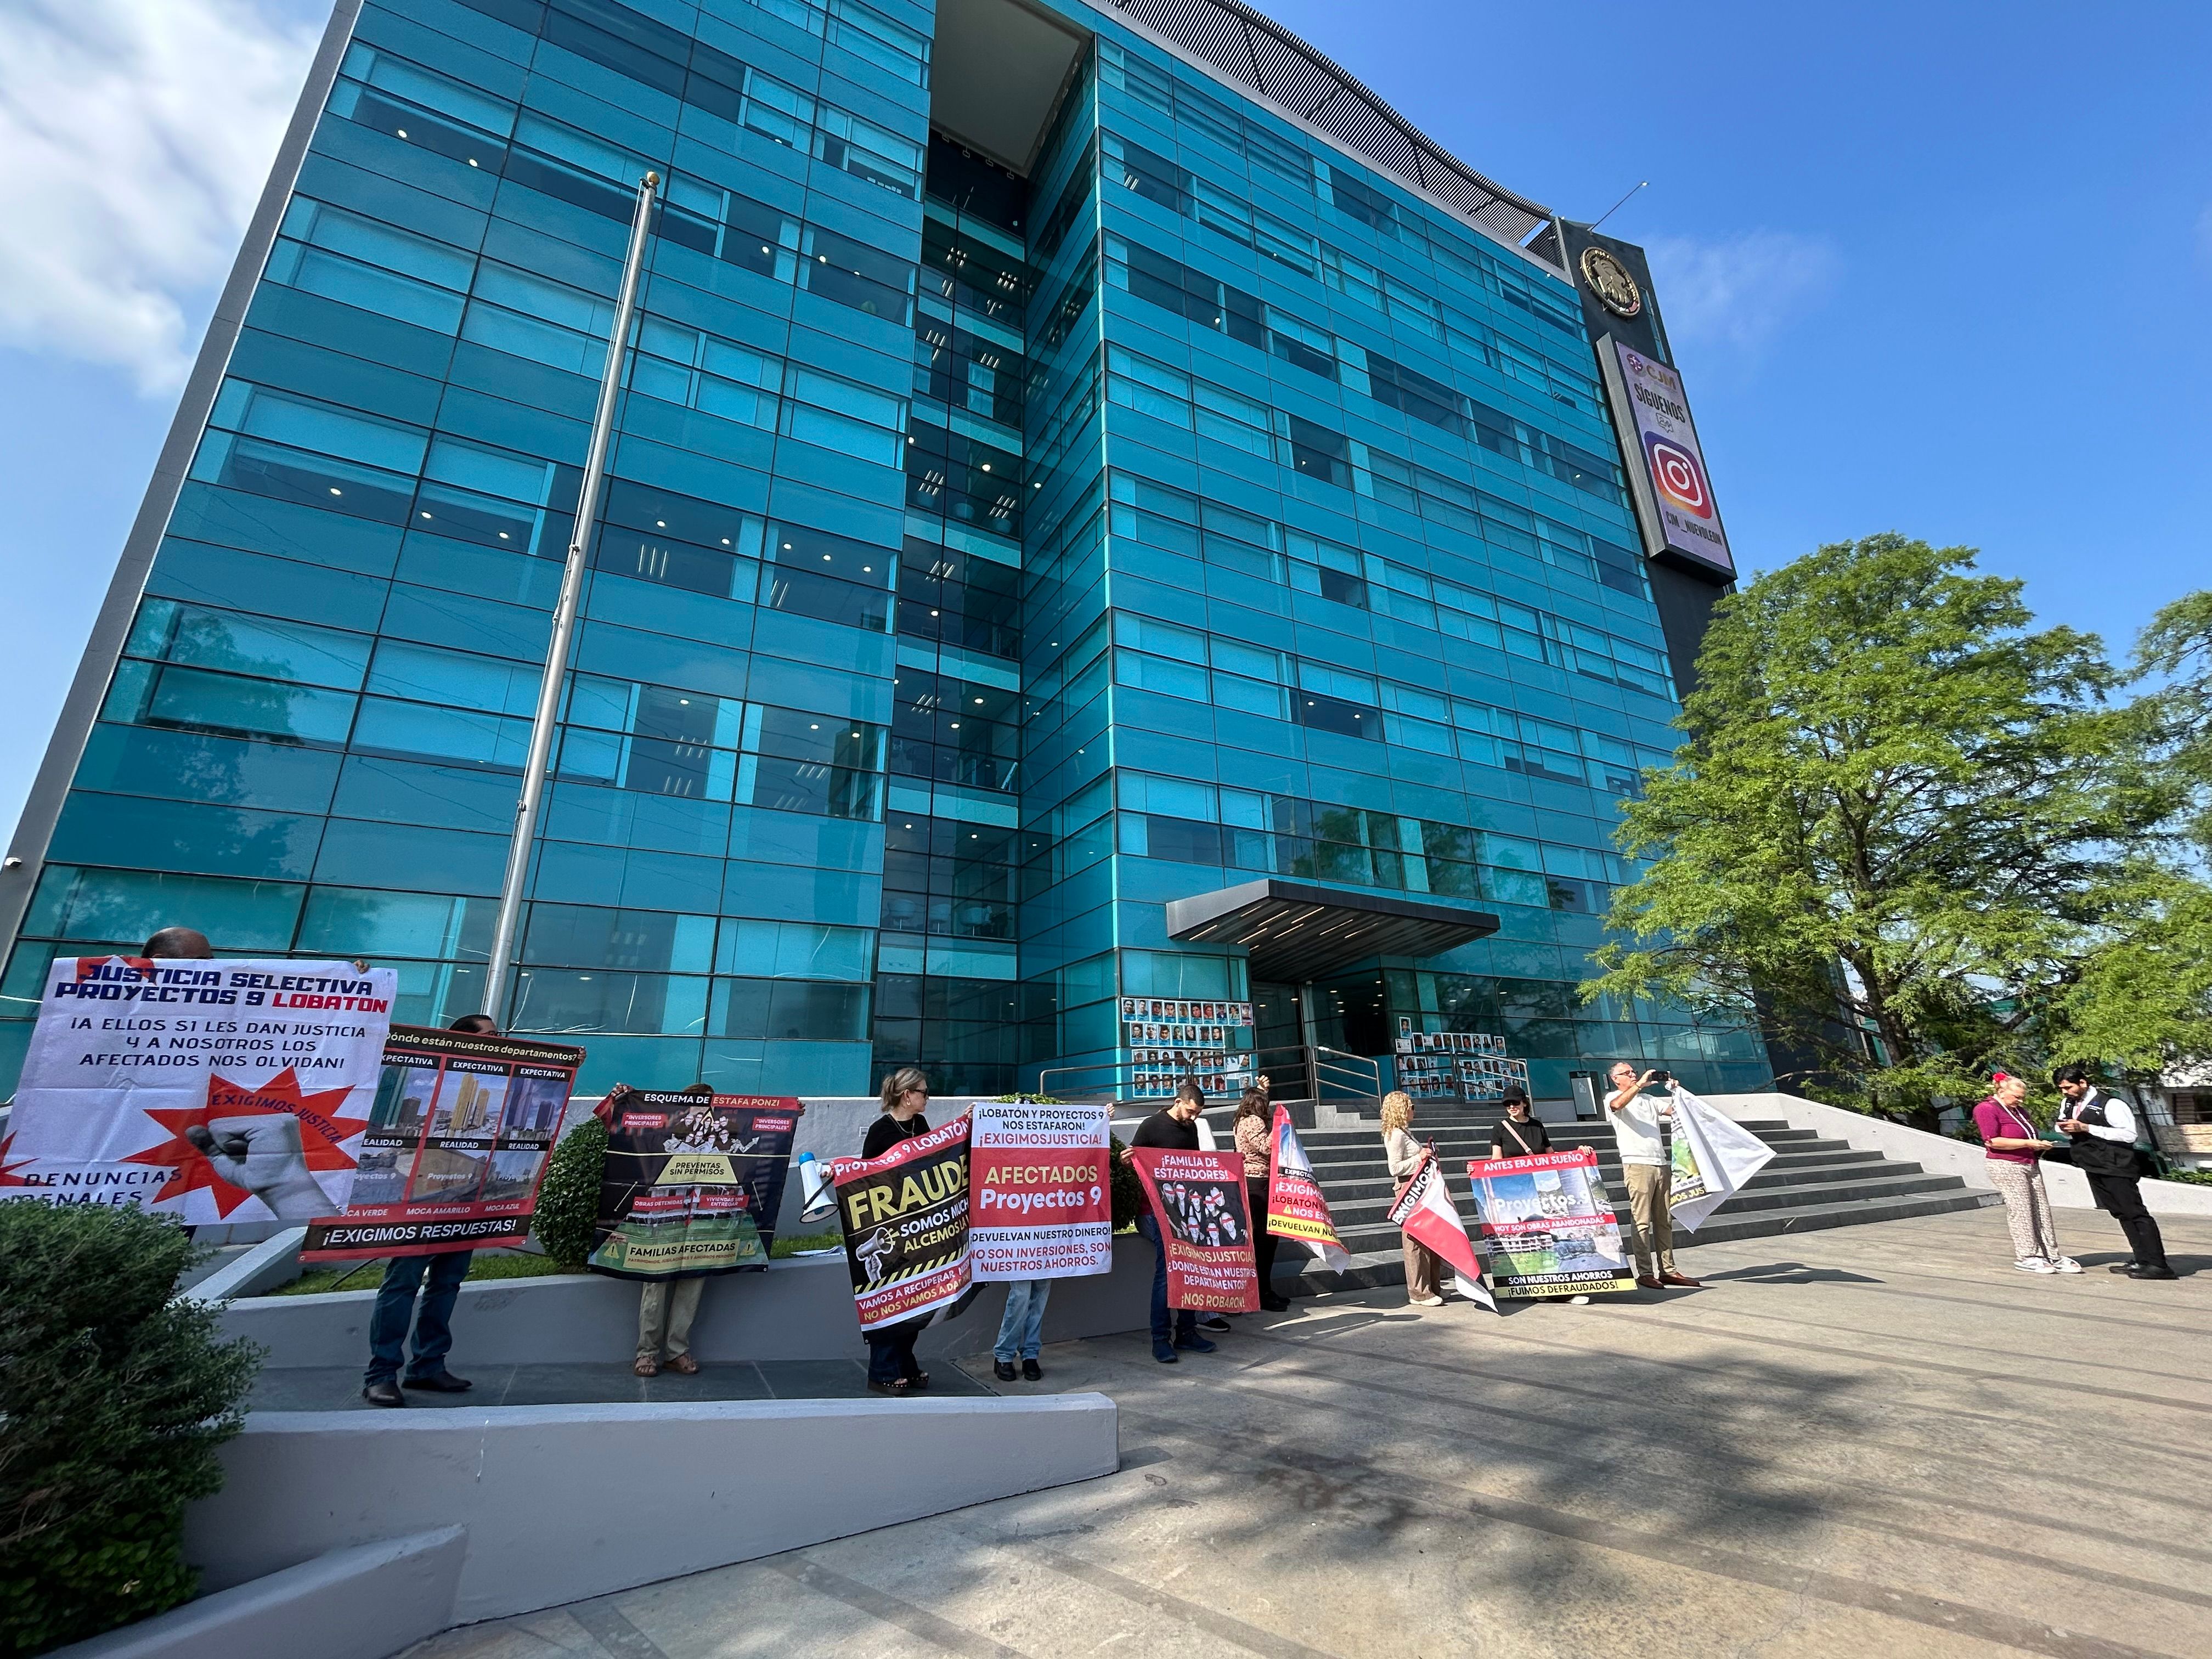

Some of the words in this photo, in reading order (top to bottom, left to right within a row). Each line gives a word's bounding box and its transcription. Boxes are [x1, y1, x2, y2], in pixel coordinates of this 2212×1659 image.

[1646, 365, 1677, 390] CJM
[1634, 383, 1685, 423] SÍGUENOS
[80, 965, 221, 986] JUSTICIA
[230, 973, 372, 995] SELECTIVA
[55, 982, 237, 1005] PROYECTOS
[245, 991, 266, 1006] 9
[272, 992, 388, 1013] LOBATON
[102, 1019, 165, 1031] ELLOS
[205, 1021, 237, 1033] LES
[246, 1023, 286, 1035] DAN
[292, 1025, 365, 1037] JUSTICIA
[146, 1037, 160, 1048] A
[170, 1037, 274, 1051] NOSOTROS
[282, 1041, 317, 1052] LOS
[422, 1037, 452, 1048] están
[454, 1041, 499, 1053] nuestros
[501, 1045, 577, 1062] departamentos?
[80, 1054, 199, 1066] AFECTADOS
[208, 1055, 247, 1066] NOS
[382, 1054, 433, 1065] XPECTATIVA
[453, 1062, 504, 1073] EXPECTATIVA
[520, 1068, 566, 1079] EXPECTATIVA
[644, 1093, 694, 1104] ESQUEMA
[713, 1097, 749, 1105] ESTAFA
[212, 1094, 296, 1113] EXIGIMOS
[294, 1108, 343, 1144] JUSTICIA
[979, 1107, 1029, 1120] ¡LOBATÓN
[1032, 1110, 1037, 1119] Y
[1040, 1110, 1097, 1120] PROYECTOS
[1099, 1111, 1104, 1120] 9
[1003, 1121, 1024, 1130] NOS
[1026, 1121, 1085, 1131] ESTAFARON!
[364, 1138, 403, 1147] EALIDAD
[508, 1142, 539, 1150] REALIDAD
[834, 1150, 902, 1176] Proyectos
[902, 1143, 911, 1153] 9
[912, 1119, 970, 1151] LOBATÓN
[1161, 1155, 1204, 1167] ¡FAMILIA
[1205, 1157, 1219, 1167] DE
[1484, 1160, 1514, 1172] ANTES
[1515, 1159, 1534, 1168] ERA
[1534, 1156, 1549, 1166] UN
[1551, 1152, 1583, 1165] SUEÑO
[24, 1169, 184, 1187] DENUNCIAS
[984, 1165, 1098, 1184] AFECTADOS
[1154, 1167, 1229, 1180] ESTAFADORES!
[1284, 1169, 1313, 1179] EXPECTA
[848, 1153, 968, 1230] FRAUDE
[1276, 1181, 1324, 1200] ¡EXIGIMO
[980, 1189, 1085, 1214] Proyectos
[1090, 1186, 1102, 1205] 9
[1272, 1195, 1318, 1209] ¡LOBATÓN
[1494, 1193, 1577, 1212] Proyectos
[900, 1209, 950, 1237] SOMOS
[951, 1197, 969, 1219] MUCH
[1293, 1207, 1313, 1217] NOS
[1315, 1211, 1333, 1226] ESTA
[1527, 1221, 1550, 1230] OBRAS
[1551, 1217, 1605, 1228] ABANDONADAS
[323, 1226, 417, 1246] ¡EXIGIMOS
[420, 1219, 517, 1238] RESPUESTAS!
[1268, 1219, 1320, 1234] ¡DEVUELVAN
[904, 1224, 960, 1253] ALCEMOS
[970, 1232, 1031, 1244] ¡DEVUELVAN
[1034, 1229, 1073, 1240] NUESTRO
[1075, 1227, 1111, 1236] DINERO!
[630, 1246, 677, 1256] FAMILIAS
[678, 1243, 735, 1254] AFECTADAS
[970, 1249, 985, 1260] NO
[988, 1248, 1013, 1259] SON
[1017, 1244, 1088, 1257] INVERSIONES,
[1090, 1242, 1111, 1252] SON
[980, 1260, 1042, 1272] NUESTROS
[1045, 1255, 1099, 1269] AHORROS.
[1223, 1267, 1256, 1278] NUESTRS
[1509, 1277, 1526, 1285] SON
[1527, 1274, 1570, 1284] NUESTROS
[1571, 1271, 1613, 1281] AHORROS
[859, 1294, 895, 1310] VAMOS
[895, 1290, 903, 1298] A
[904, 1271, 955, 1295] RECUPERAR
[1509, 1285, 1545, 1297] ¡FUIMOS
[1548, 1280, 1618, 1293] DEFRAUDADOS!
[864, 1310, 878, 1321] NO
[881, 1302, 901, 1316] NOS
[902, 1289, 937, 1307] VAMOS
[939, 1285, 946, 1295] A
[1181, 1293, 1204, 1308] ¡NOS
[1206, 1295, 1245, 1308] ROBARON!
